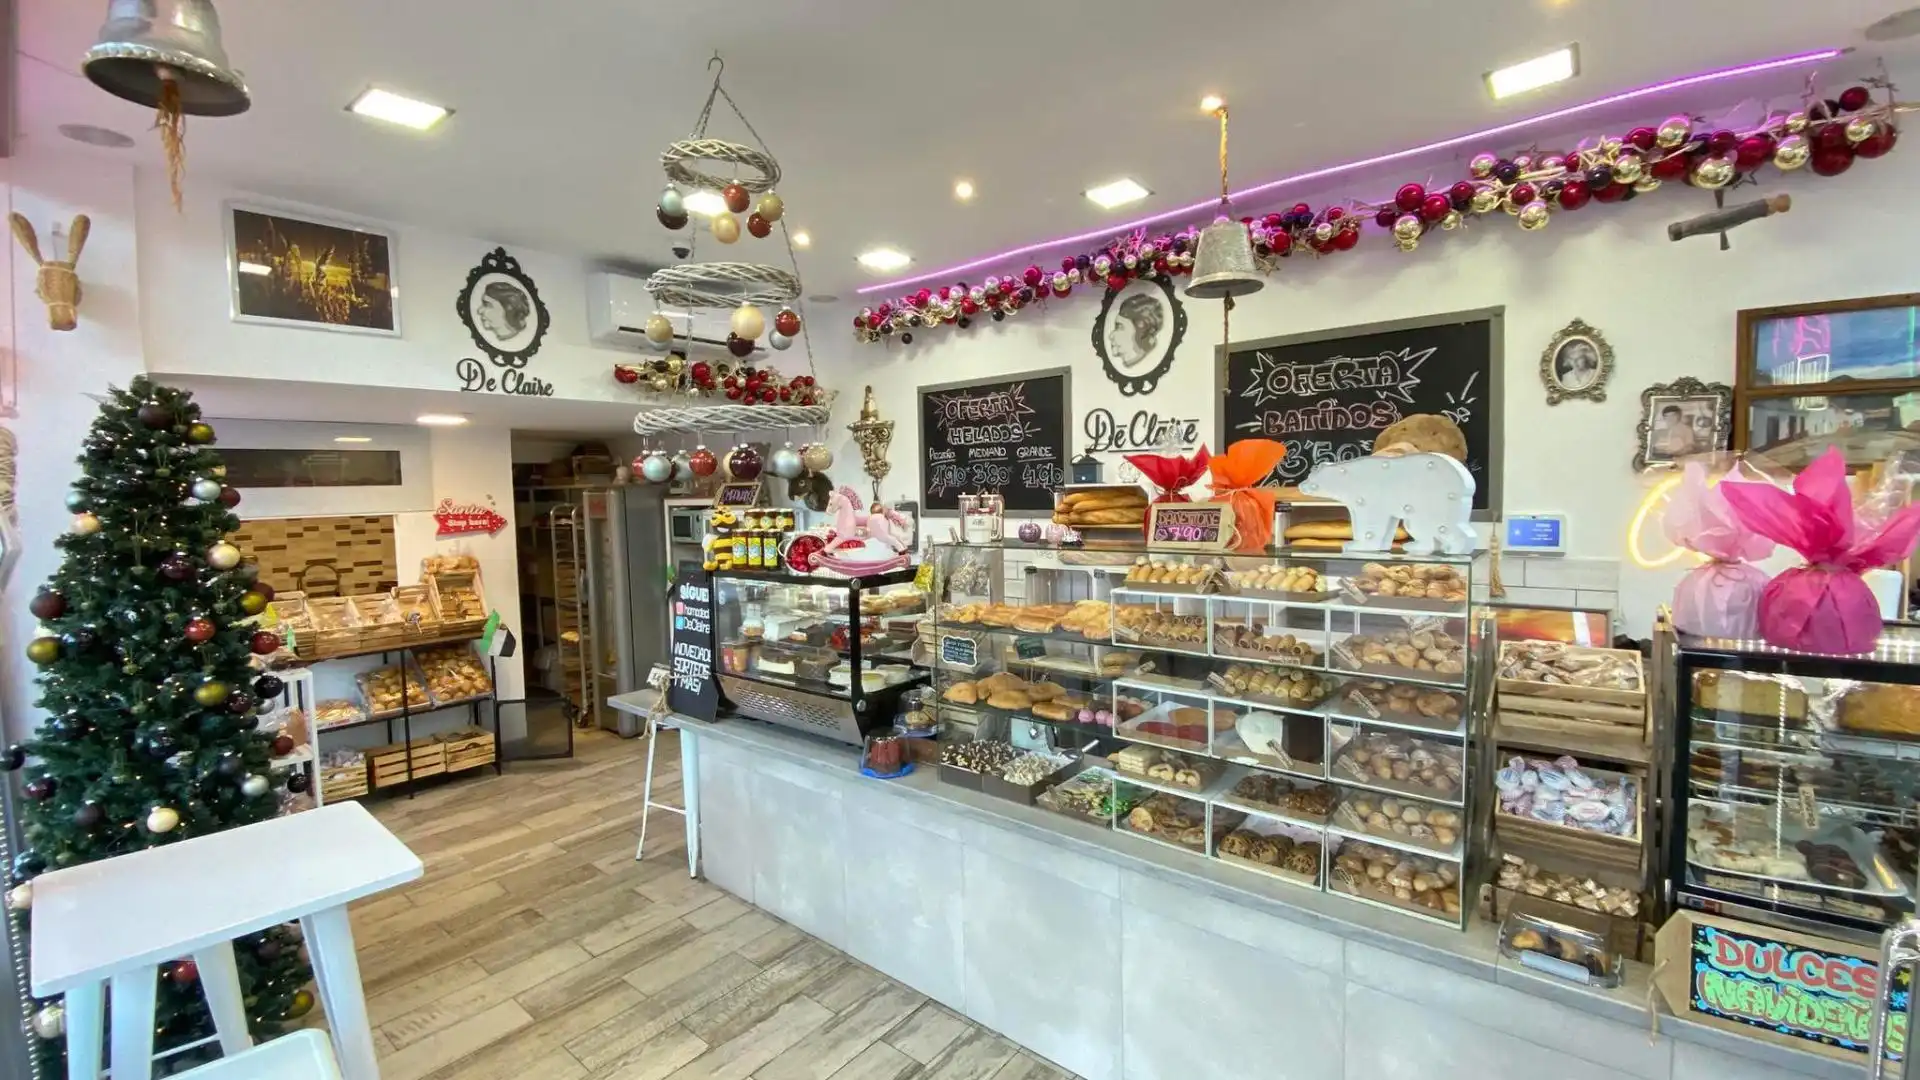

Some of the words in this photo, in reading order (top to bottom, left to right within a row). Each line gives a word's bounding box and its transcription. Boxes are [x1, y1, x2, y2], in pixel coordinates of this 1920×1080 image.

[456, 358, 497, 392] De
[501, 368, 554, 396] Claire
[1266, 355, 1400, 396] OFERTA
[945, 394, 1016, 420] OFERTA
[947, 423, 1024, 445] HELADOS
[1084, 408, 1126, 453] De
[968, 446, 1007, 459] MEDIANO
[1016, 446, 1053, 459] GRANDE
[1714, 934, 1878, 998] DULCES
